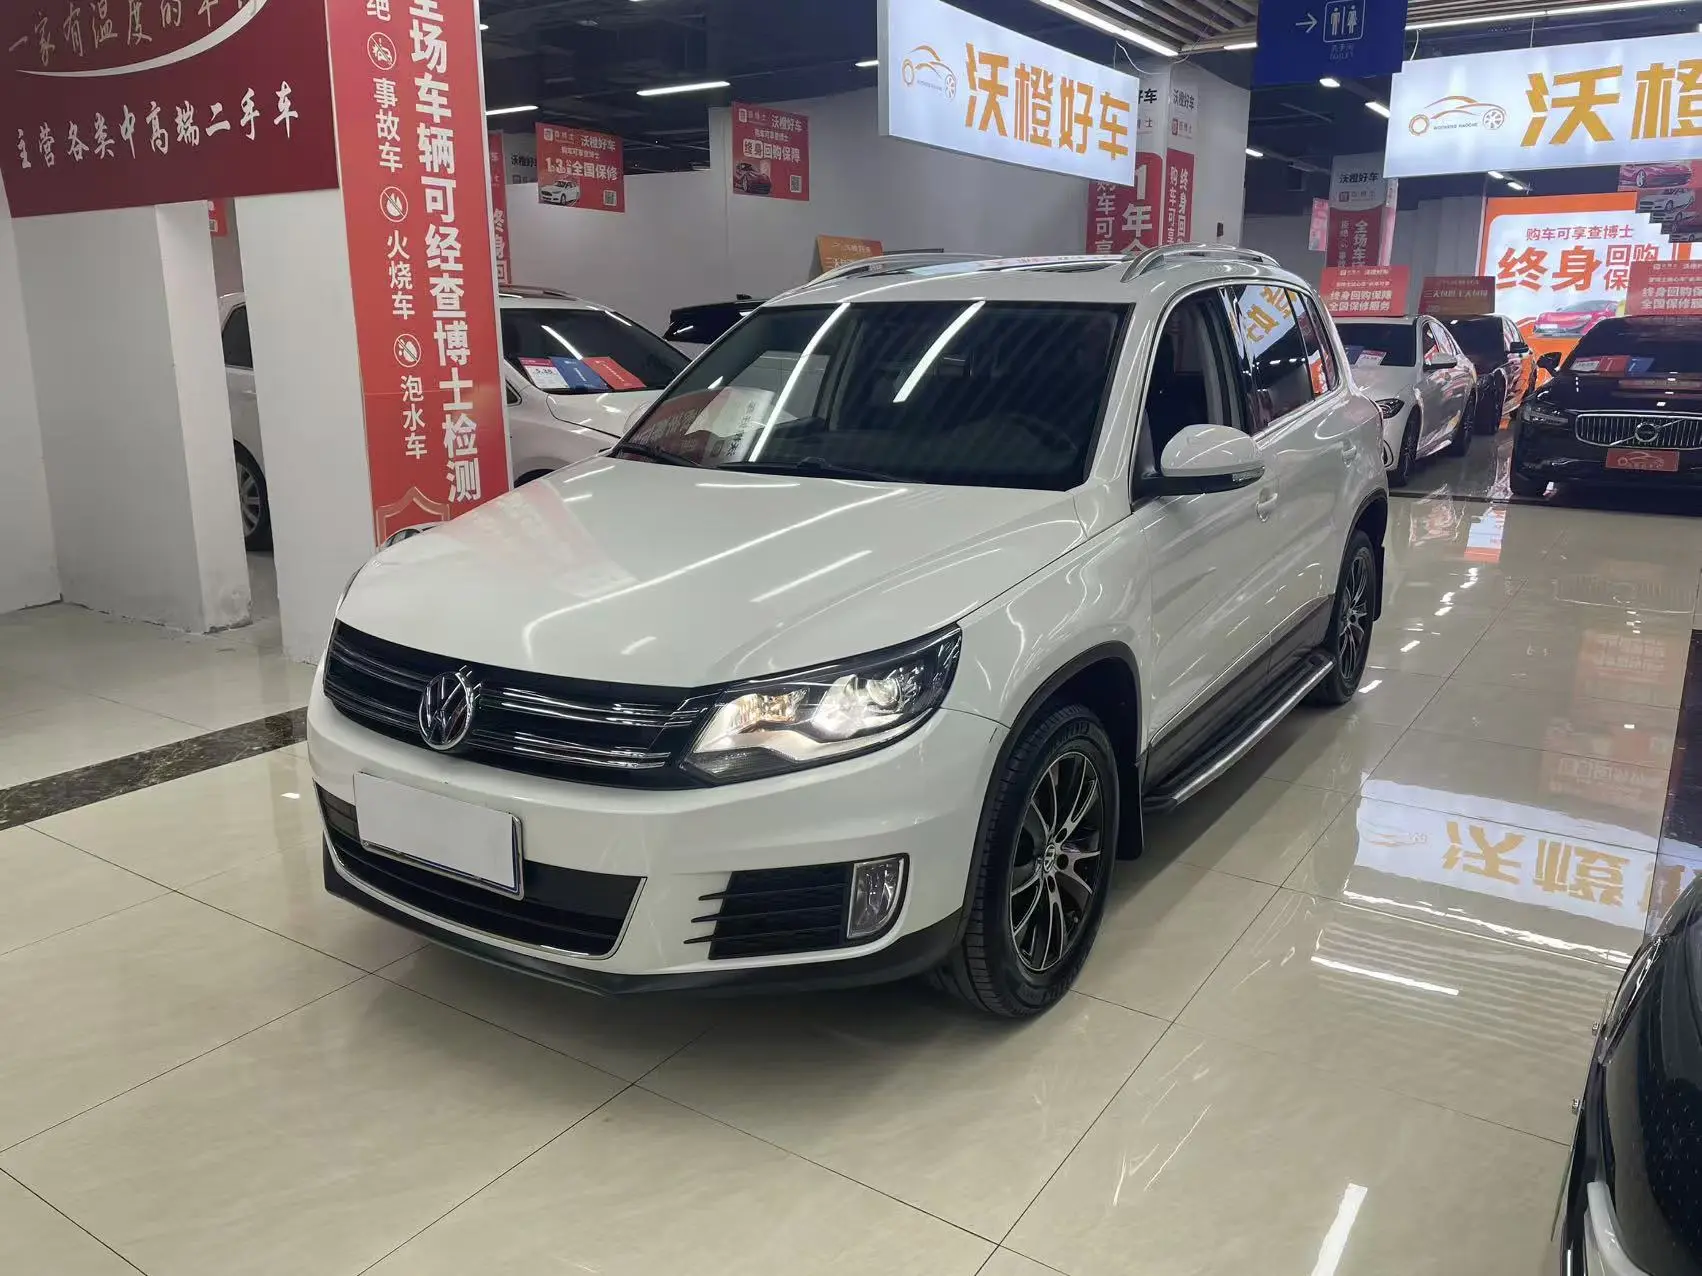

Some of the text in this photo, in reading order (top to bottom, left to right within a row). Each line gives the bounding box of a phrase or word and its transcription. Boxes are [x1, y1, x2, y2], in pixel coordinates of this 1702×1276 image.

[16, 80, 299, 169] 主营各类中高端二手车
[372, 77, 403, 172] 事故车
[964, 41, 1131, 161] 沃橙好车
[1520, 59, 1702, 147] 沃橙
[387, 230, 415, 320] 火烧车
[1496, 242, 1660, 292] 终身 回购
[1526, 224, 1635, 241] 购车可享查博士
[400, 375, 428, 459] 泡水车
